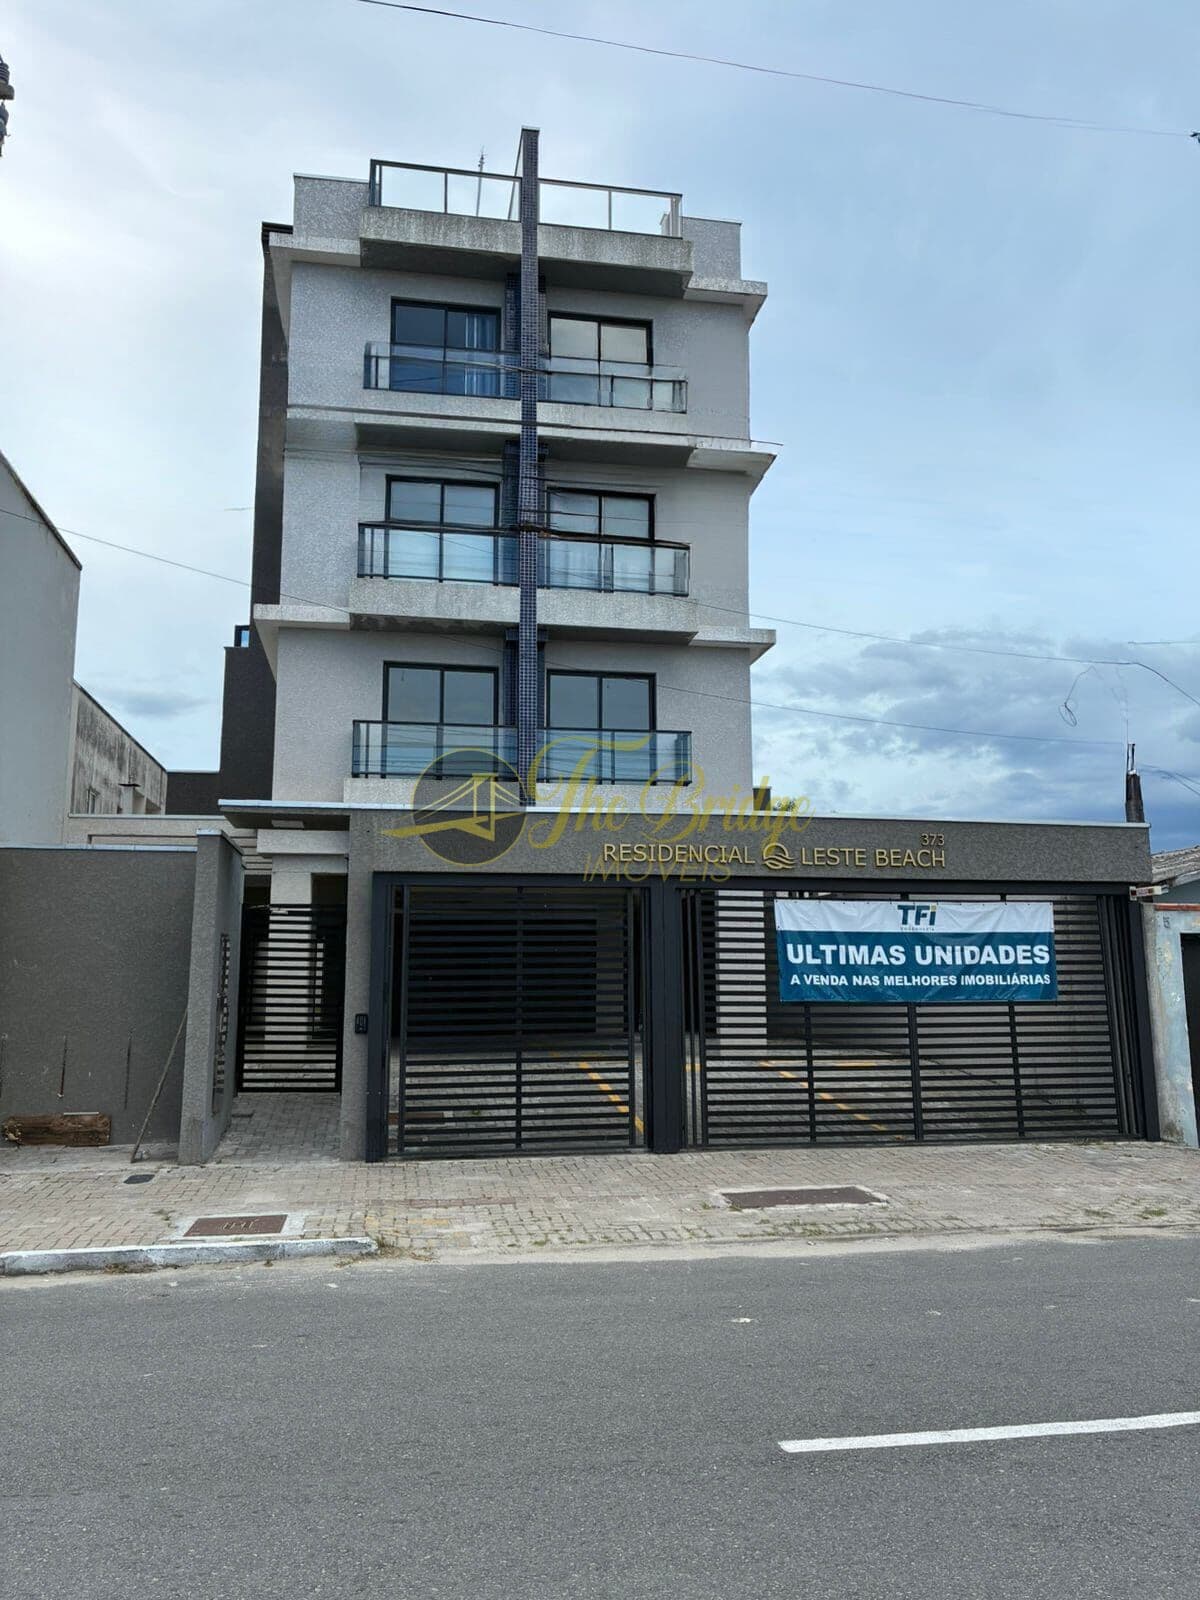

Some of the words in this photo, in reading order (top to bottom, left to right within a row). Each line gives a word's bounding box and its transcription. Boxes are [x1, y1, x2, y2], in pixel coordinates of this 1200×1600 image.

[921, 833, 945, 846] 373
[603, 843, 756, 865] RESIDENCIAL
[802, 848, 867, 866] LESTE
[876, 849, 946, 867] BEACH
[786, 943, 906, 965] ULTIMAS
[914, 945, 1050, 965] UNIDADES
[790, 974, 801, 985] A
[804, 975, 849, 986] VENDA
[852, 975, 880, 986] NAS
[883, 975, 957, 986] MELHORES
[960, 972, 1051, 985] IMOBILIÁRIAS
